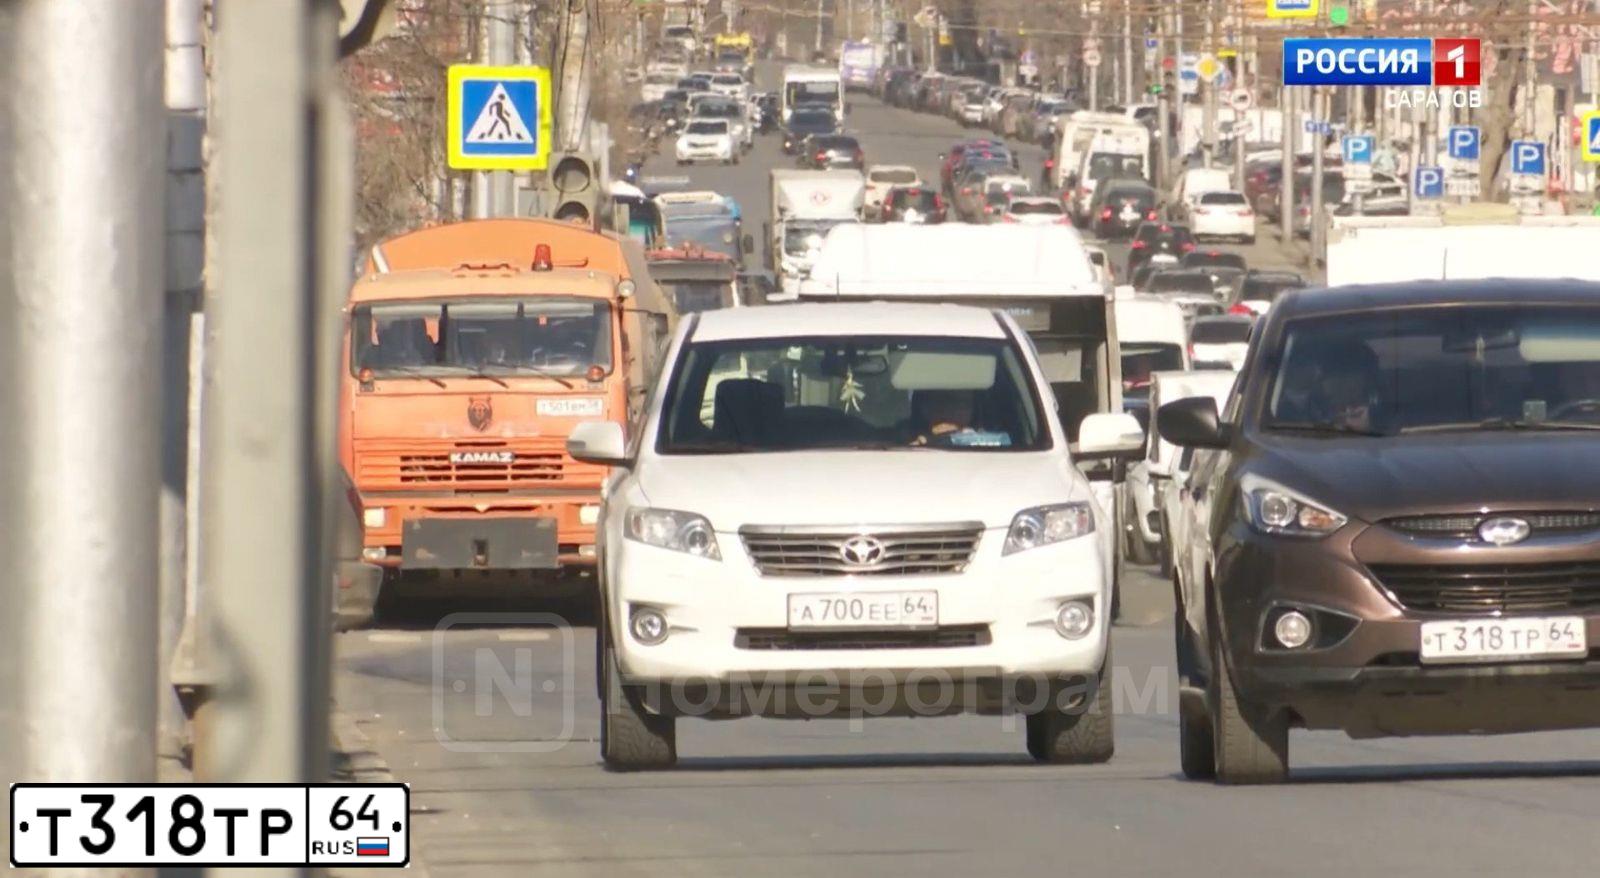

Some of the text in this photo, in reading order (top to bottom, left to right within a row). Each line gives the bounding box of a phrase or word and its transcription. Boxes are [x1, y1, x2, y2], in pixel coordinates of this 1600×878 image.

[449, 451, 514, 464] KAMAZ
[904, 596, 928, 614] 64
[1433, 621, 1575, 652] Т318ТР 64
